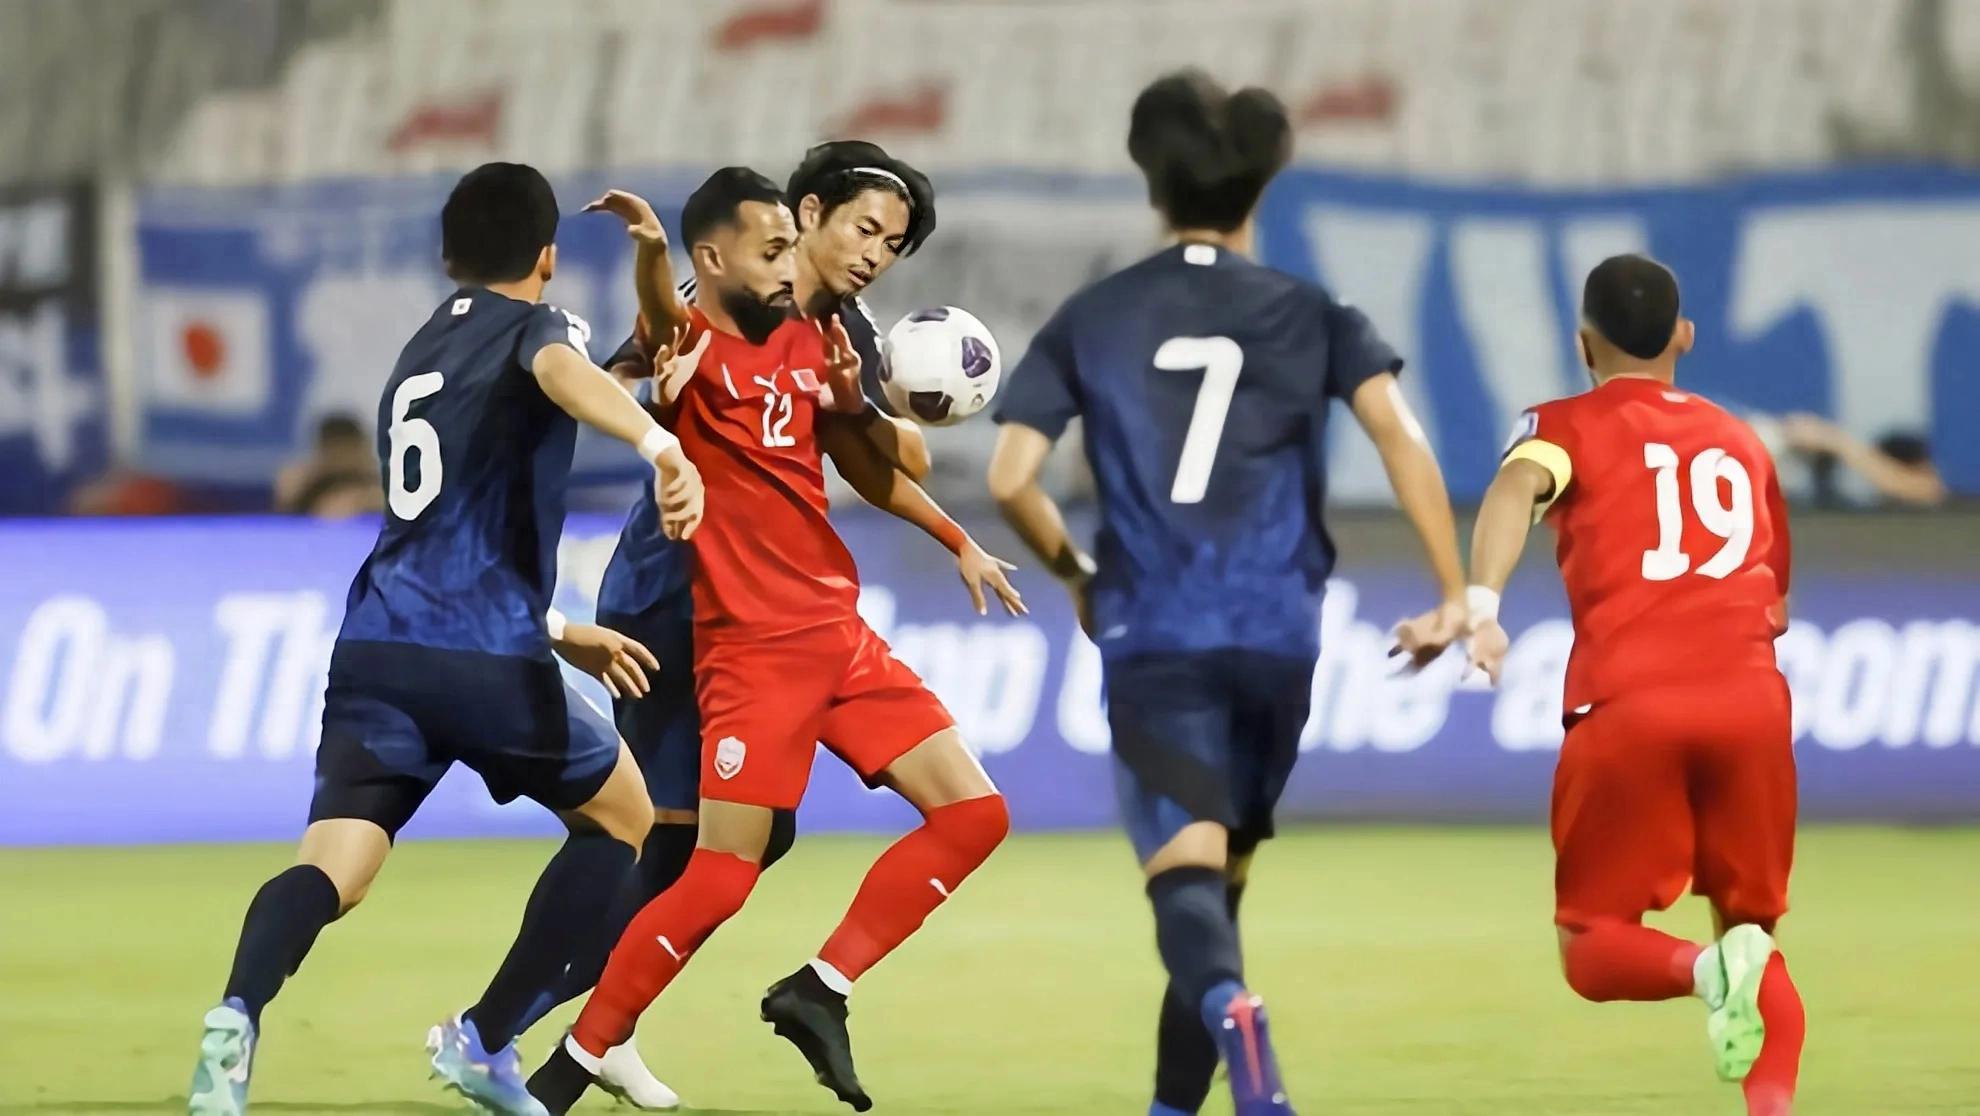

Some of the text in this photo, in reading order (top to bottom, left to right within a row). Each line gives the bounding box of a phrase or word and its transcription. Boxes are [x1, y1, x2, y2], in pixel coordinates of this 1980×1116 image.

[388, 371, 444, 521] 6
[762, 393, 796, 447] 12
[1154, 337, 1243, 503] 7
[1642, 443, 1754, 580] 19
[6, 589, 340, 761] On Th
